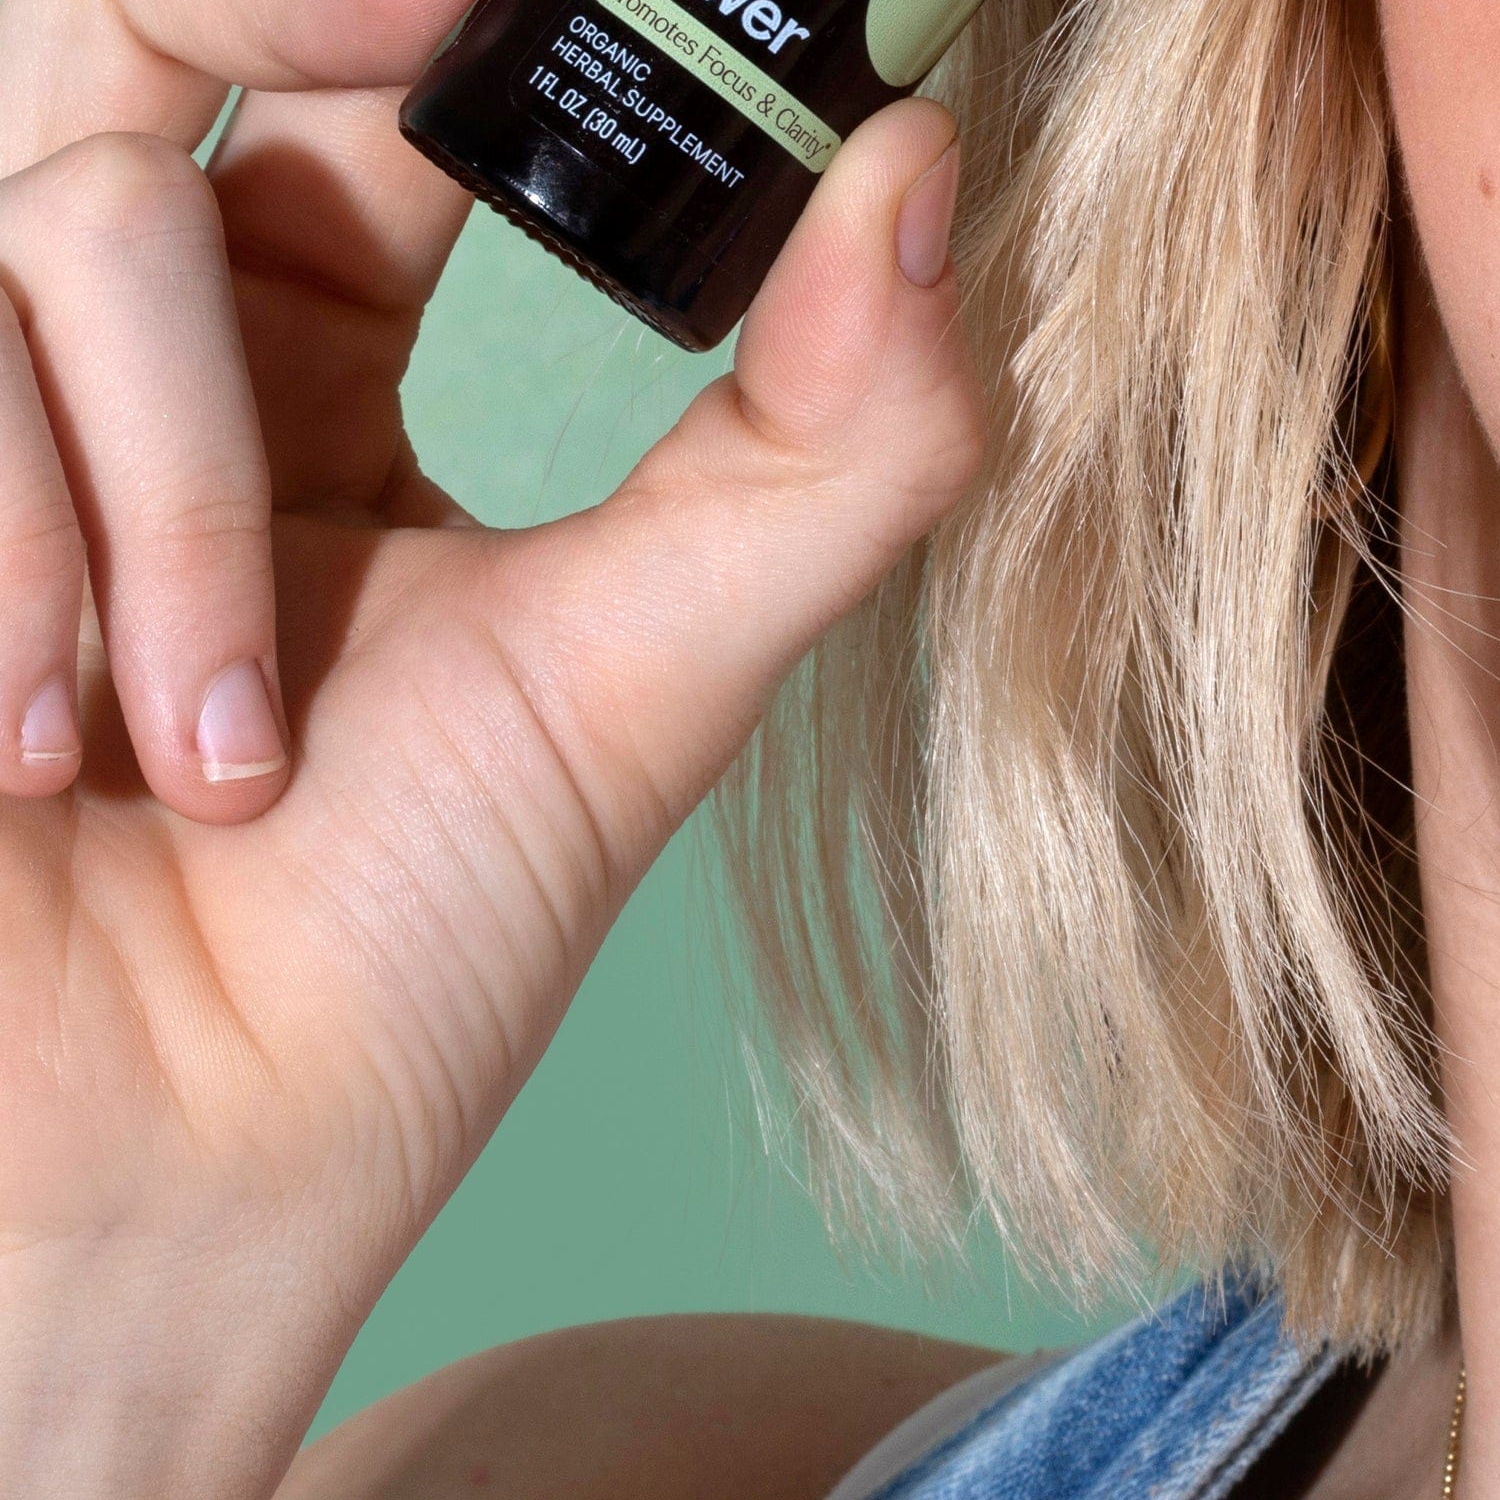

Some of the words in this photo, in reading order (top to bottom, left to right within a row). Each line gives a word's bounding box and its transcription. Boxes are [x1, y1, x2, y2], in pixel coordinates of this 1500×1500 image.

[569, 16, 651, 82] ORGANIC
[698, 45, 757, 102] Focus
[756, 93, 776, 118] &
[529, 65, 544, 85] 1
[537, 72, 559, 100] FL.
[559, 88, 587, 119] OZ.
[582, 107, 618, 140] (30
[611, 131, 646, 165] mL)
[551, 35, 622, 98] HERBAL
[622, 89, 745, 189] SUPPLEMENT
